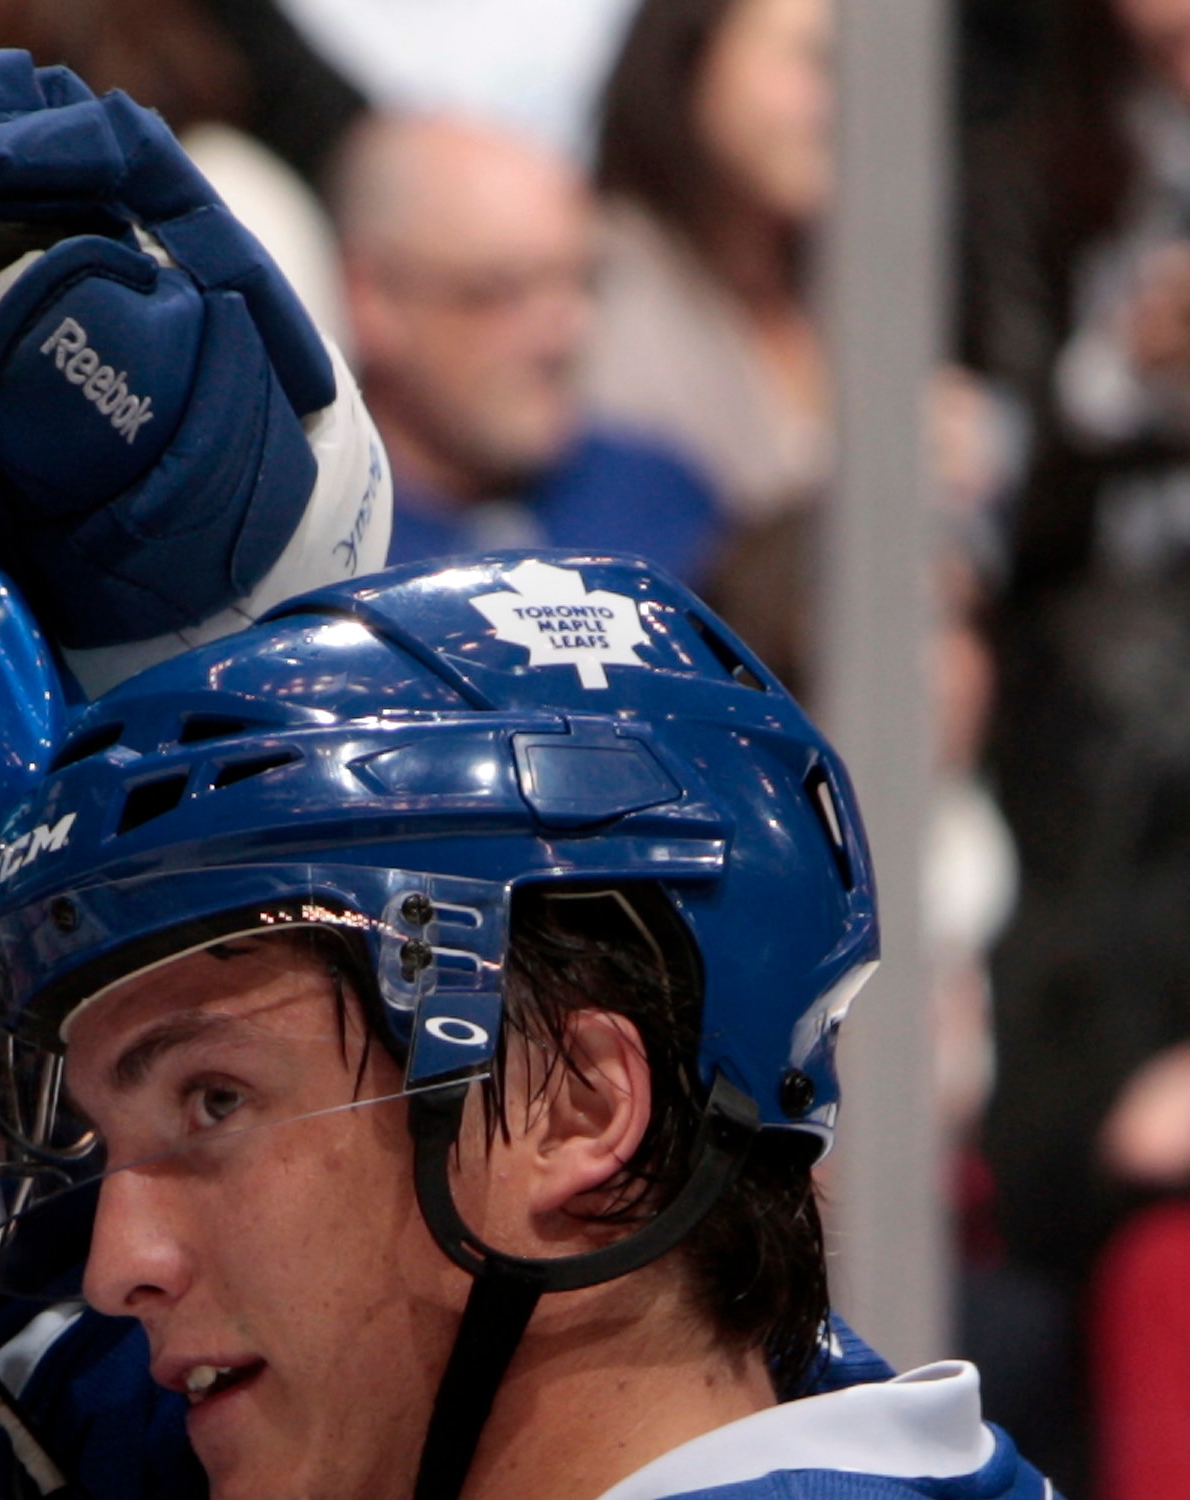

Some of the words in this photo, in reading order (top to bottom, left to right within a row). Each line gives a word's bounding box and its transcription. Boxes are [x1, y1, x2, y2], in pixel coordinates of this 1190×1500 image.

[40, 317, 154, 444] Reebok
[512, 605, 615, 619] TORONTO
[537, 620, 607, 633] MAPLE
[548, 635, 611, 649] LEAFS
